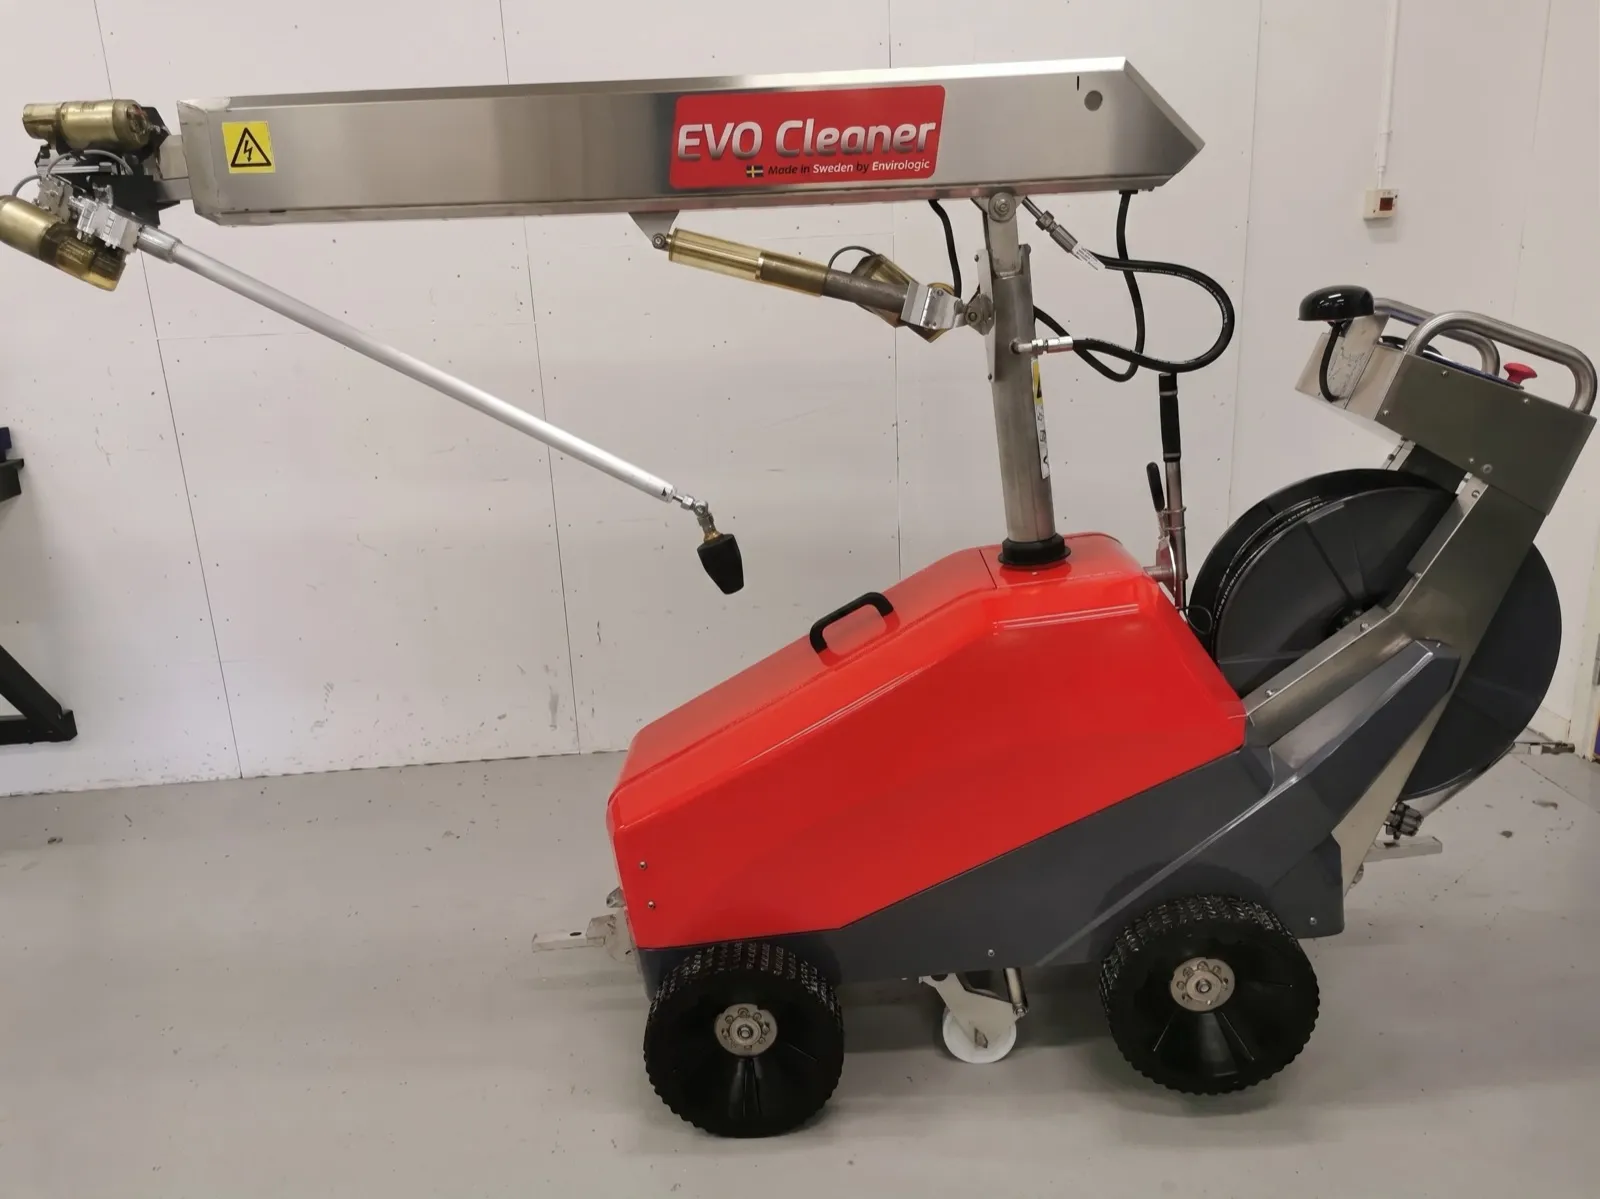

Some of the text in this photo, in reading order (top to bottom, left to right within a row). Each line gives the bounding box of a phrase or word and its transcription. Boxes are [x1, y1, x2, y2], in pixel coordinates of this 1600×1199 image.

[678, 118, 936, 161] EVO Cleaner
[768, 158, 930, 175] Made in Sweden by Envirologic
